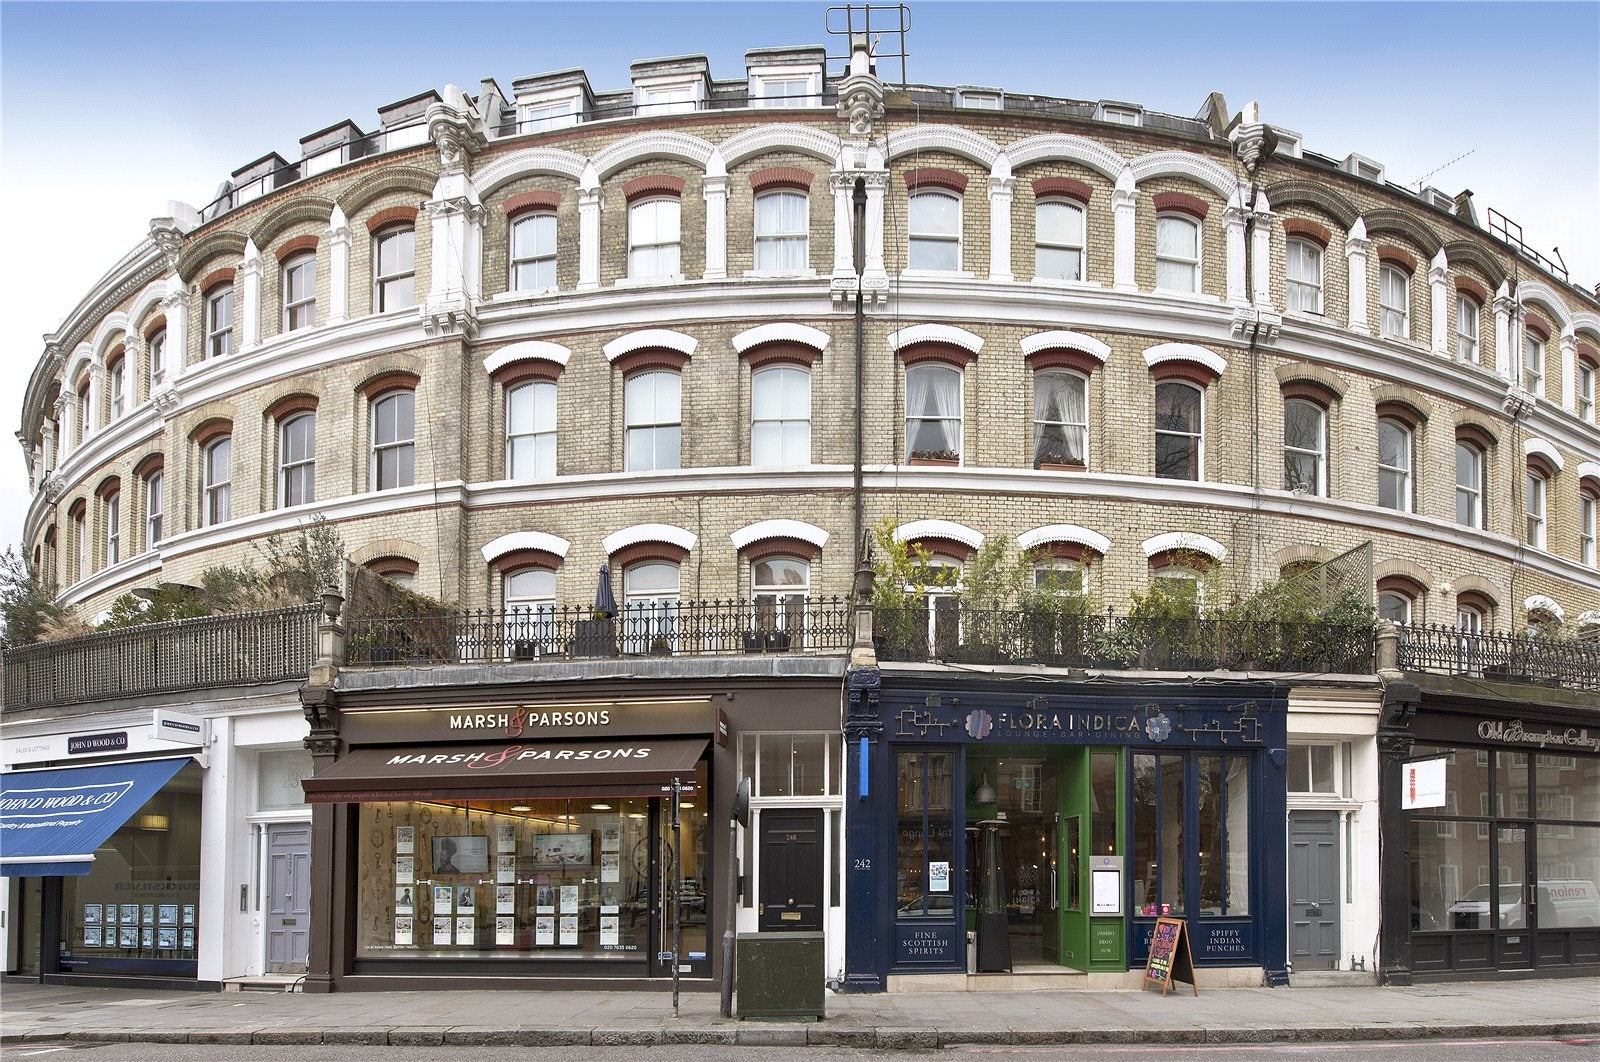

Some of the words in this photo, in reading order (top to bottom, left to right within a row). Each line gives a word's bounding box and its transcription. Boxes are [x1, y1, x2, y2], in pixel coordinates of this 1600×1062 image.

[450, 714, 509, 730] MARSH
[504, 707, 530, 738] &
[528, 710, 611, 728] PARSONS
[998, 713, 1063, 730] FLORA
[1068, 714, 1141, 731] INDICA
[997, 730, 1048, 739] LOUNGE
[1060, 730, 1084, 738] BAR
[1095, 731, 1140, 739] DINING
[1478, 720, 1503, 740] Old
[70, 740, 86, 751] JOHN
[86, 740, 92, 748] D
[92, 738, 110, 748] WOOD
[110, 738, 116, 746] &
[386, 752, 486, 765] MARSH
[467, 745, 534, 769] &
[517, 748, 652, 761] PARSONS
[27, 797, 44, 809] D
[41, 795, 84, 809] WOOD
[854, 858, 871, 868] 242
[914, 931, 937, 939] FINE
[1210, 929, 1240, 937] SPIFFY
[902, 939, 948, 947] SCOTTISH
[908, 947, 944, 955] SPIRITS
